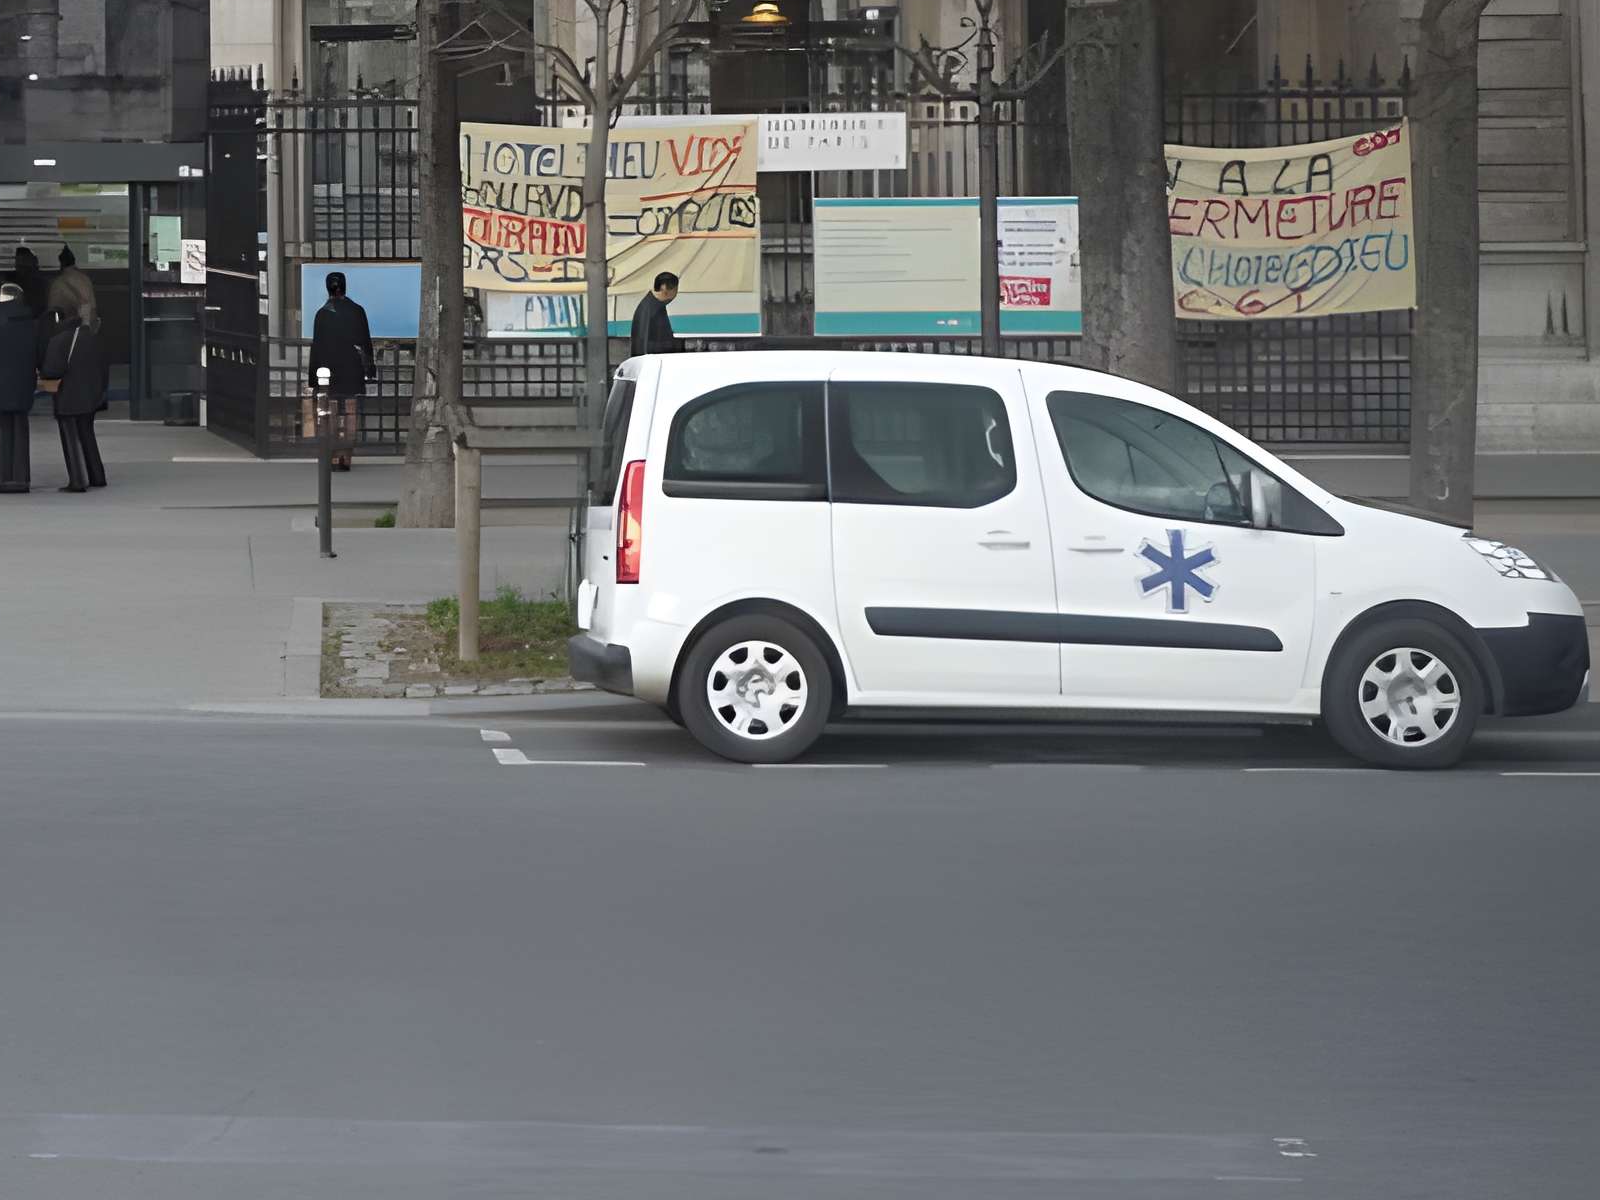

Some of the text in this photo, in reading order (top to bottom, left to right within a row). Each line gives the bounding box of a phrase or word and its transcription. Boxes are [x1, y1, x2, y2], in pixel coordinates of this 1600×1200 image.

[1217, 160, 1249, 196] A
[1272, 153, 1334, 196] LA
[1168, 177, 1407, 240] ERMETURE
